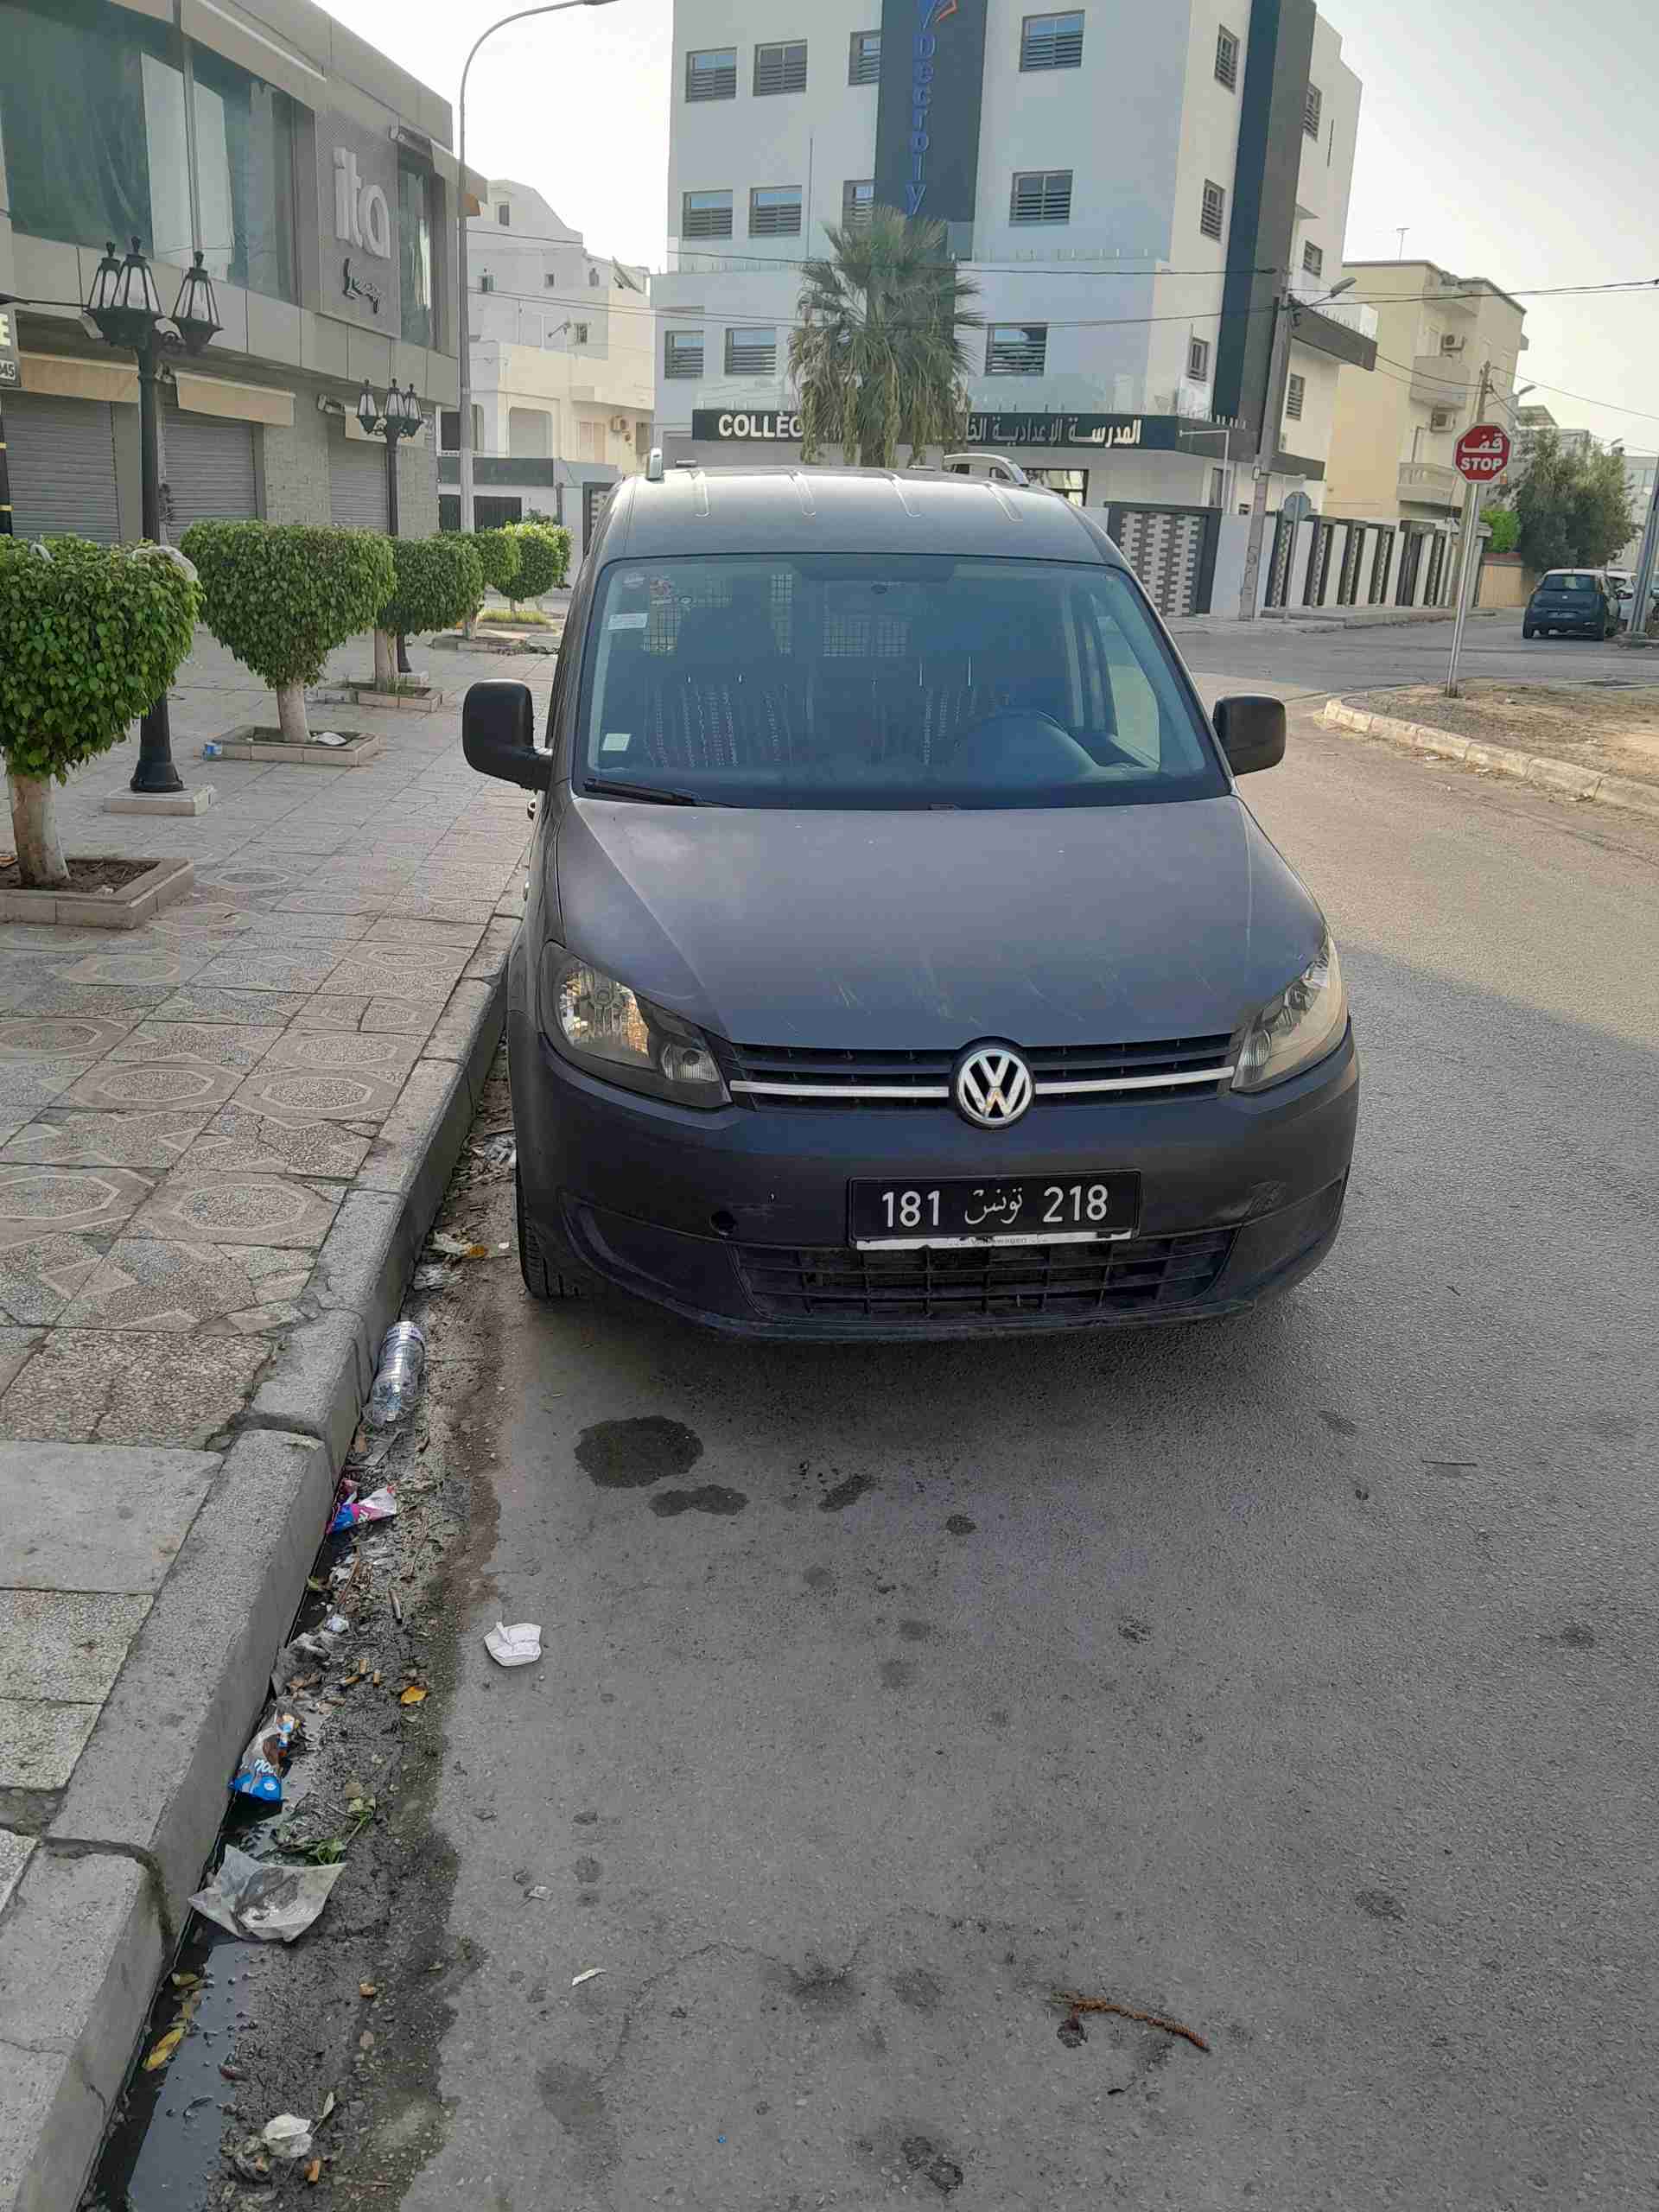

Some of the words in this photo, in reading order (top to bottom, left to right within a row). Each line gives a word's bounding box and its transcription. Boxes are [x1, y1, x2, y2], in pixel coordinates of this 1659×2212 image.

[906, 32, 936, 219] Decroly
[718, 411, 804, 437] COLLÈG
[1068, 417, 1142, 448] المدرسة
[1461, 432, 1503, 454] قف
[1460, 457, 1503, 471] STOP
[881, 1190, 940, 1228] 181
[964, 1187, 1023, 1224] تونس
[1042, 1184, 1109, 1223] 218
